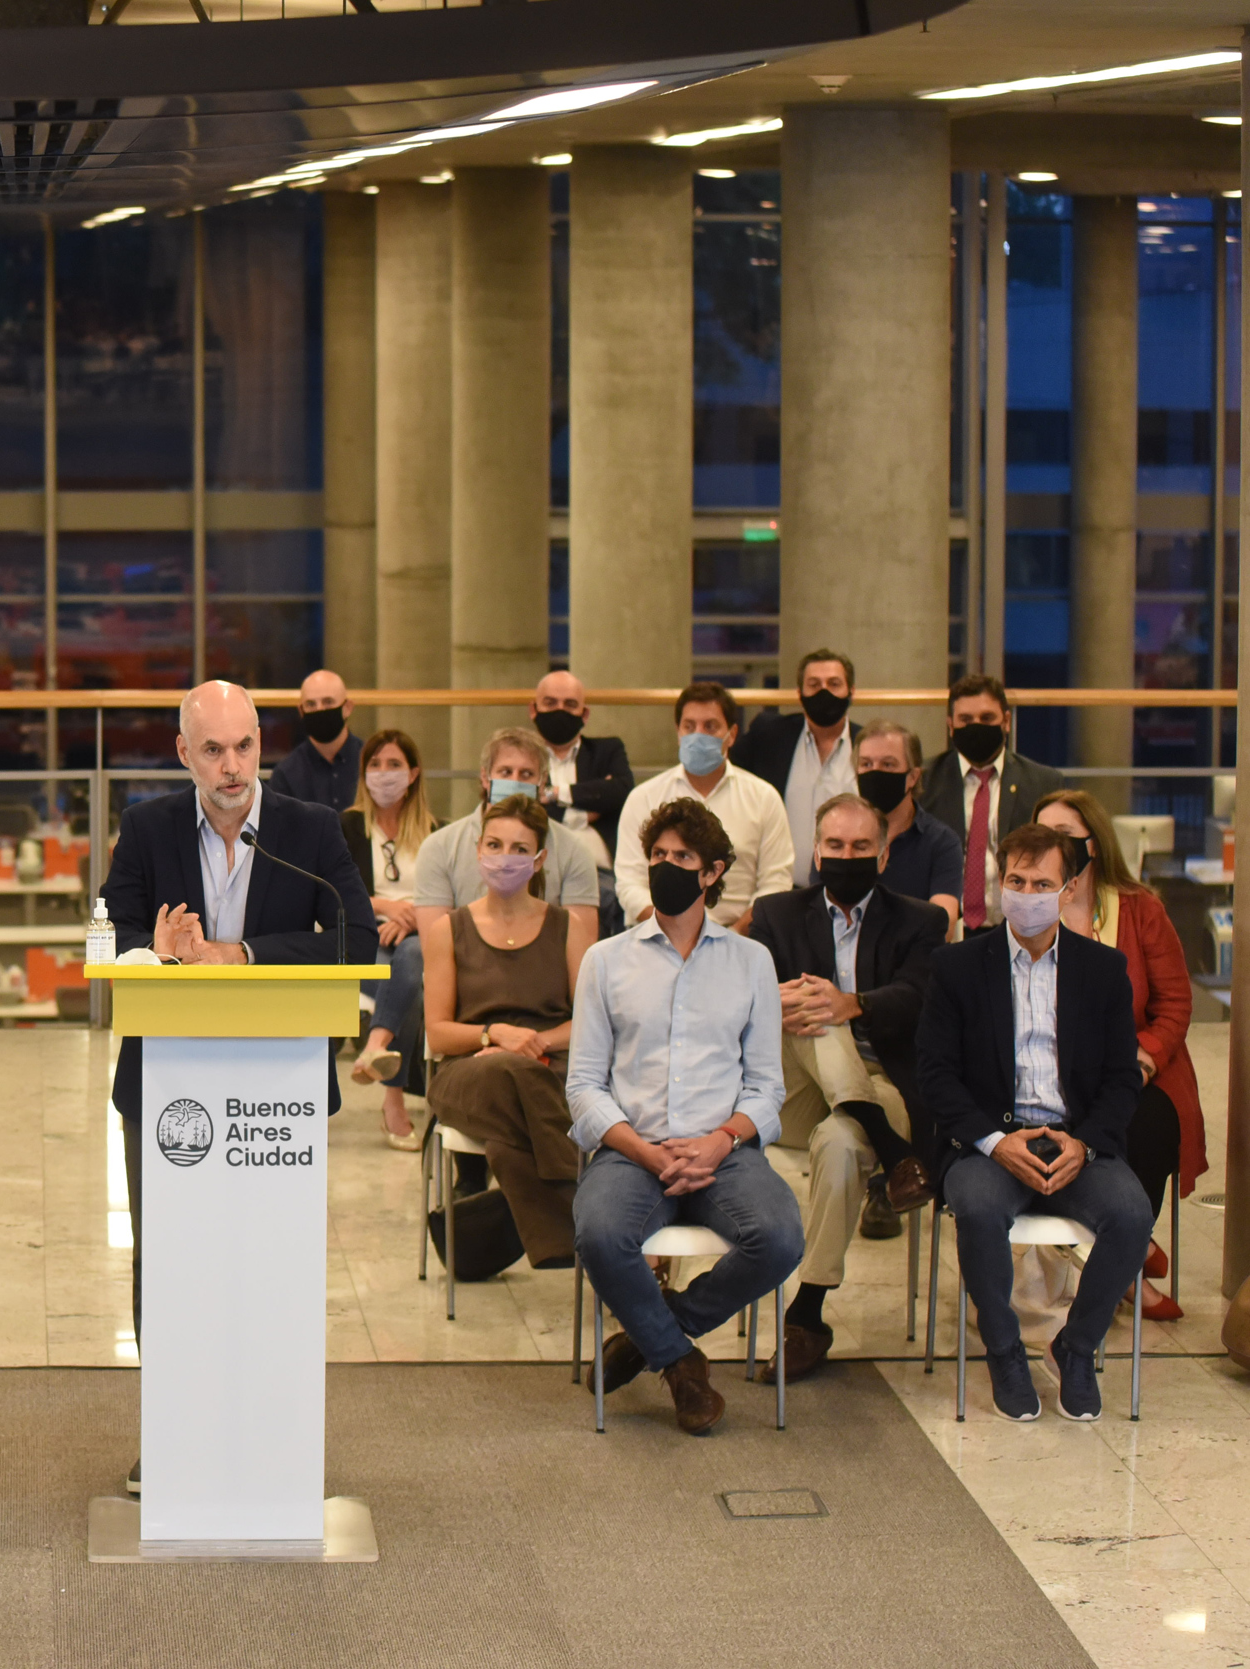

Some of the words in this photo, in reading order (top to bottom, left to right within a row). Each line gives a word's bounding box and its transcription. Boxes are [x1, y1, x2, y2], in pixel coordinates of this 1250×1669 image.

[225, 1098, 316, 1117] Buenos
[225, 1122, 293, 1142] Aires
[225, 1145, 314, 1167] Ciudad
